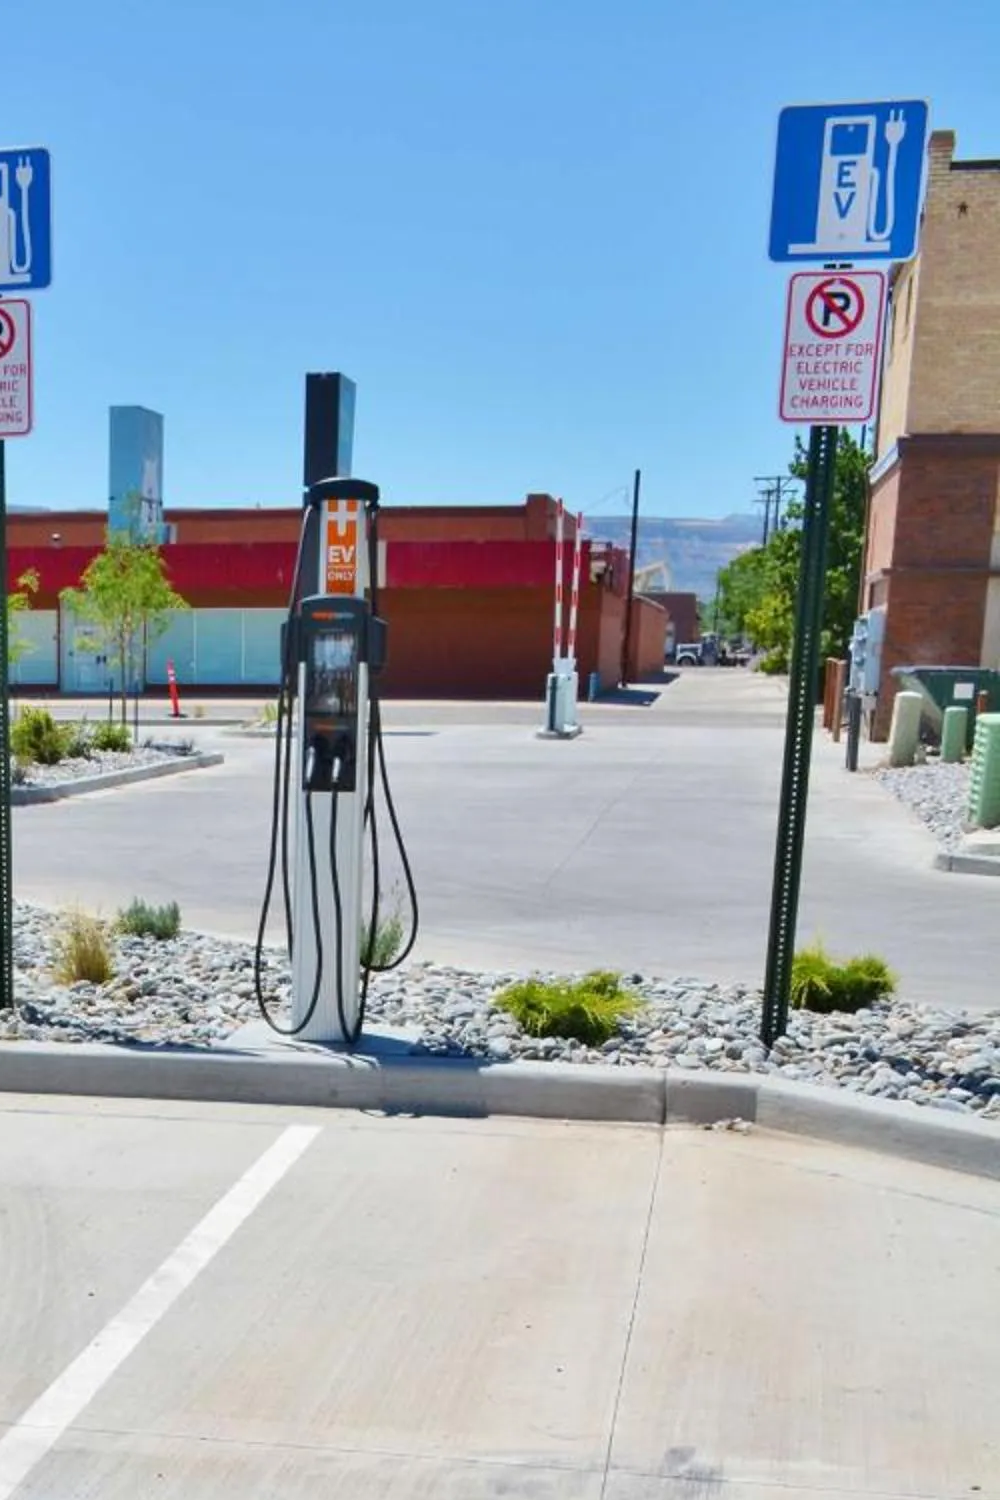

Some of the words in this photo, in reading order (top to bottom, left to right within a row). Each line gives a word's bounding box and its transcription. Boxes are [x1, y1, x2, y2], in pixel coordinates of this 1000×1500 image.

[834, 161, 858, 219] EV
[790, 344, 842, 357] EXCEPT
[845, 343, 873, 356] FOR
[4, 364, 26, 376] FOR
[797, 361, 863, 374] ELECTRIC
[799, 379, 856, 391] VEHICLE
[791, 395, 863, 408] CHARGING
[327, 545, 355, 563] EV
[327, 571, 355, 581] ONLY
